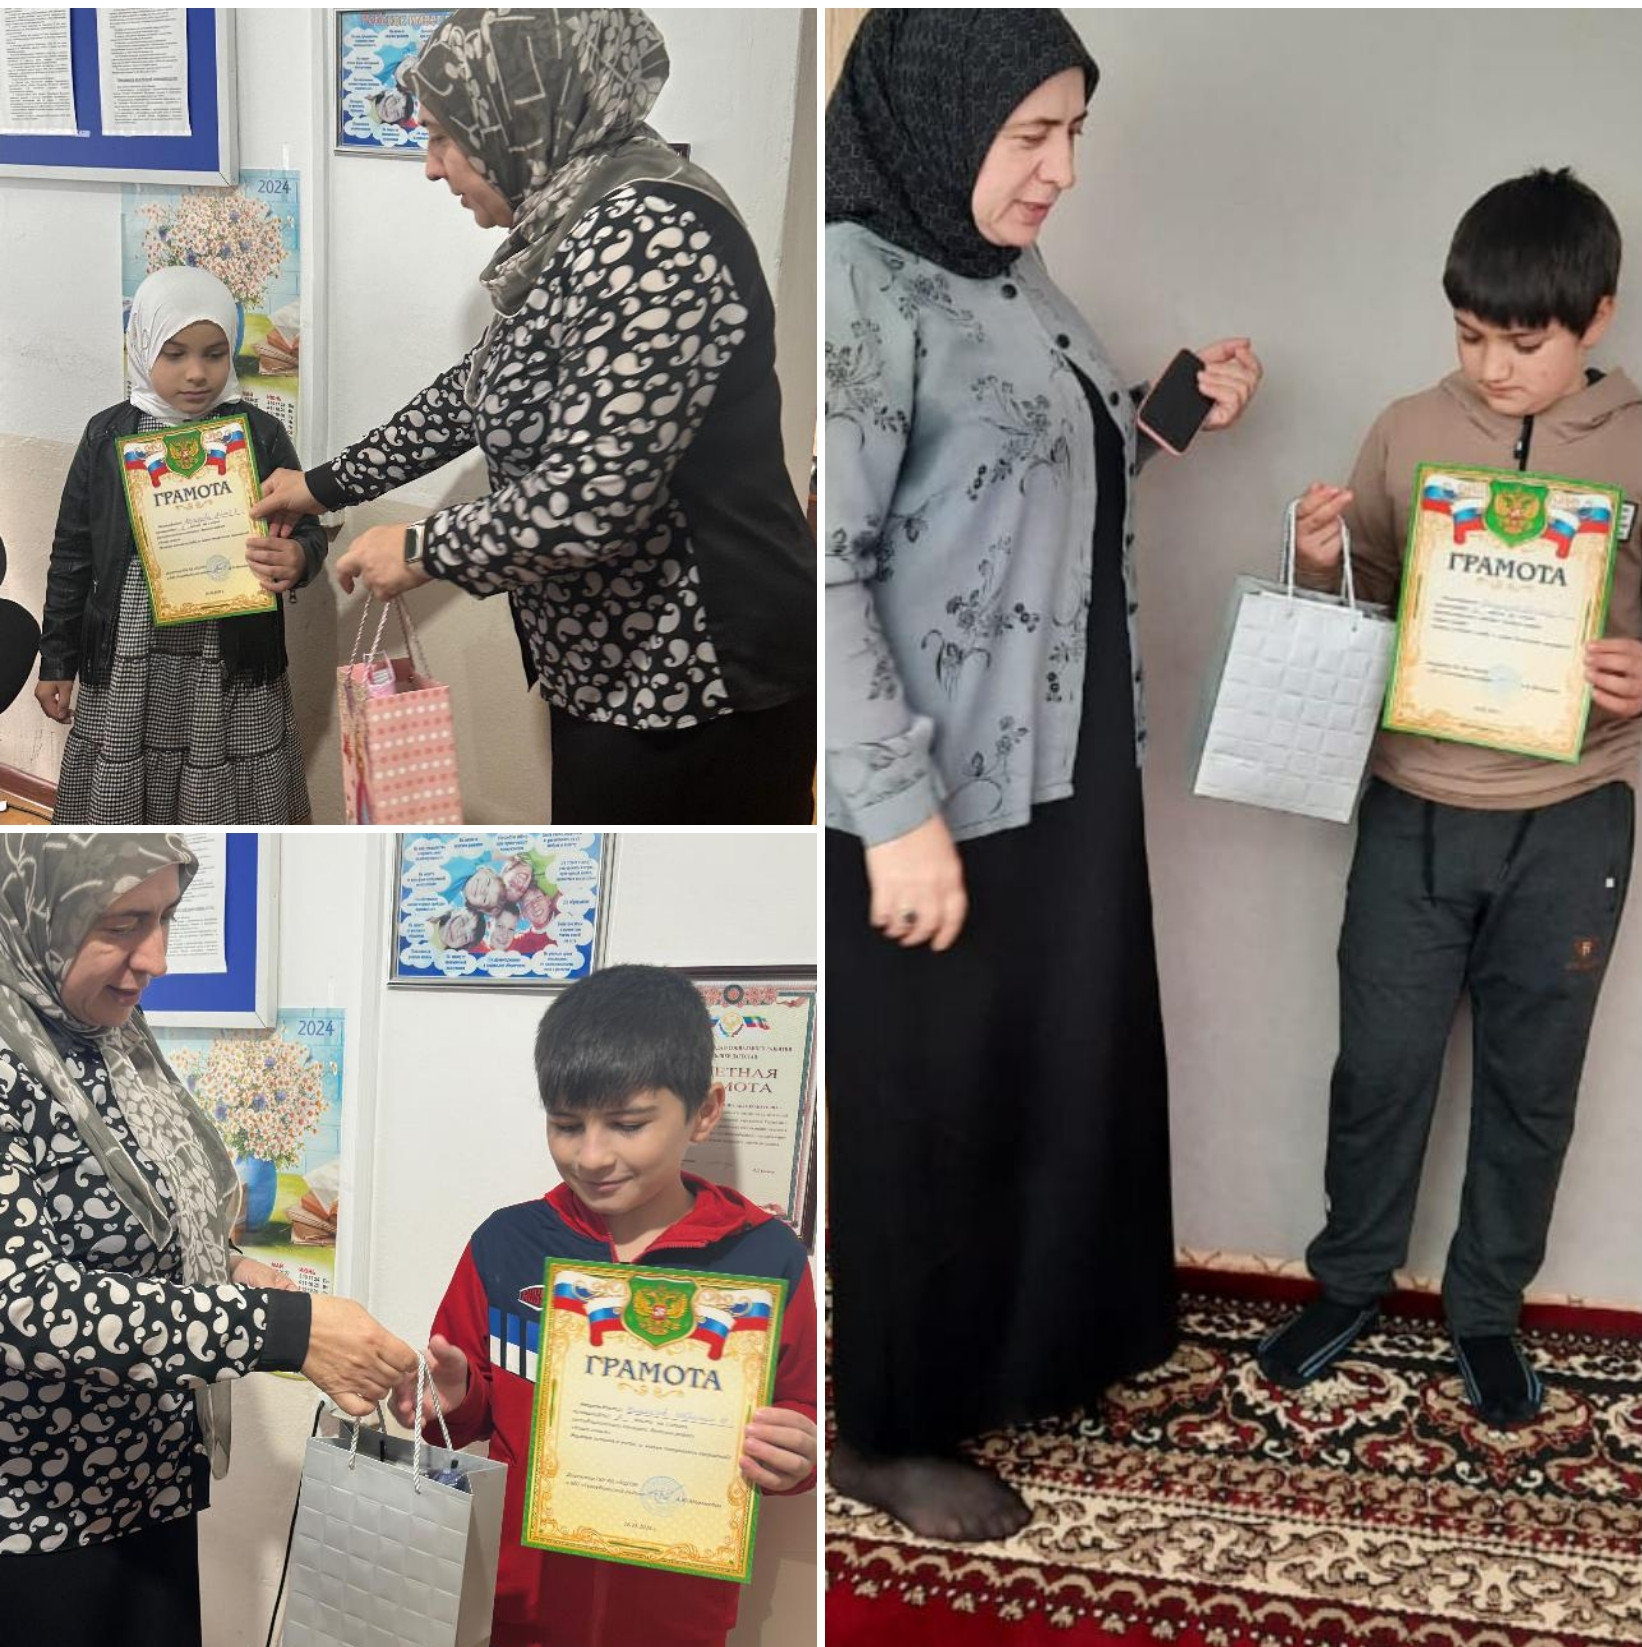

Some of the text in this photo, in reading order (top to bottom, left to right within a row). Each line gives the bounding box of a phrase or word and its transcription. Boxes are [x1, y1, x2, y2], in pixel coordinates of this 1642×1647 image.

[257, 179, 292, 195] 2024
[153, 480, 233, 507] ГРАМОТА
[1447, 551, 1568, 587] ГРАМОТА
[297, 1019, 336, 1038] 2024
[714, 1066, 778, 1079] ЕТНАЯ
[585, 1355, 722, 1391] ГРАМОТА
